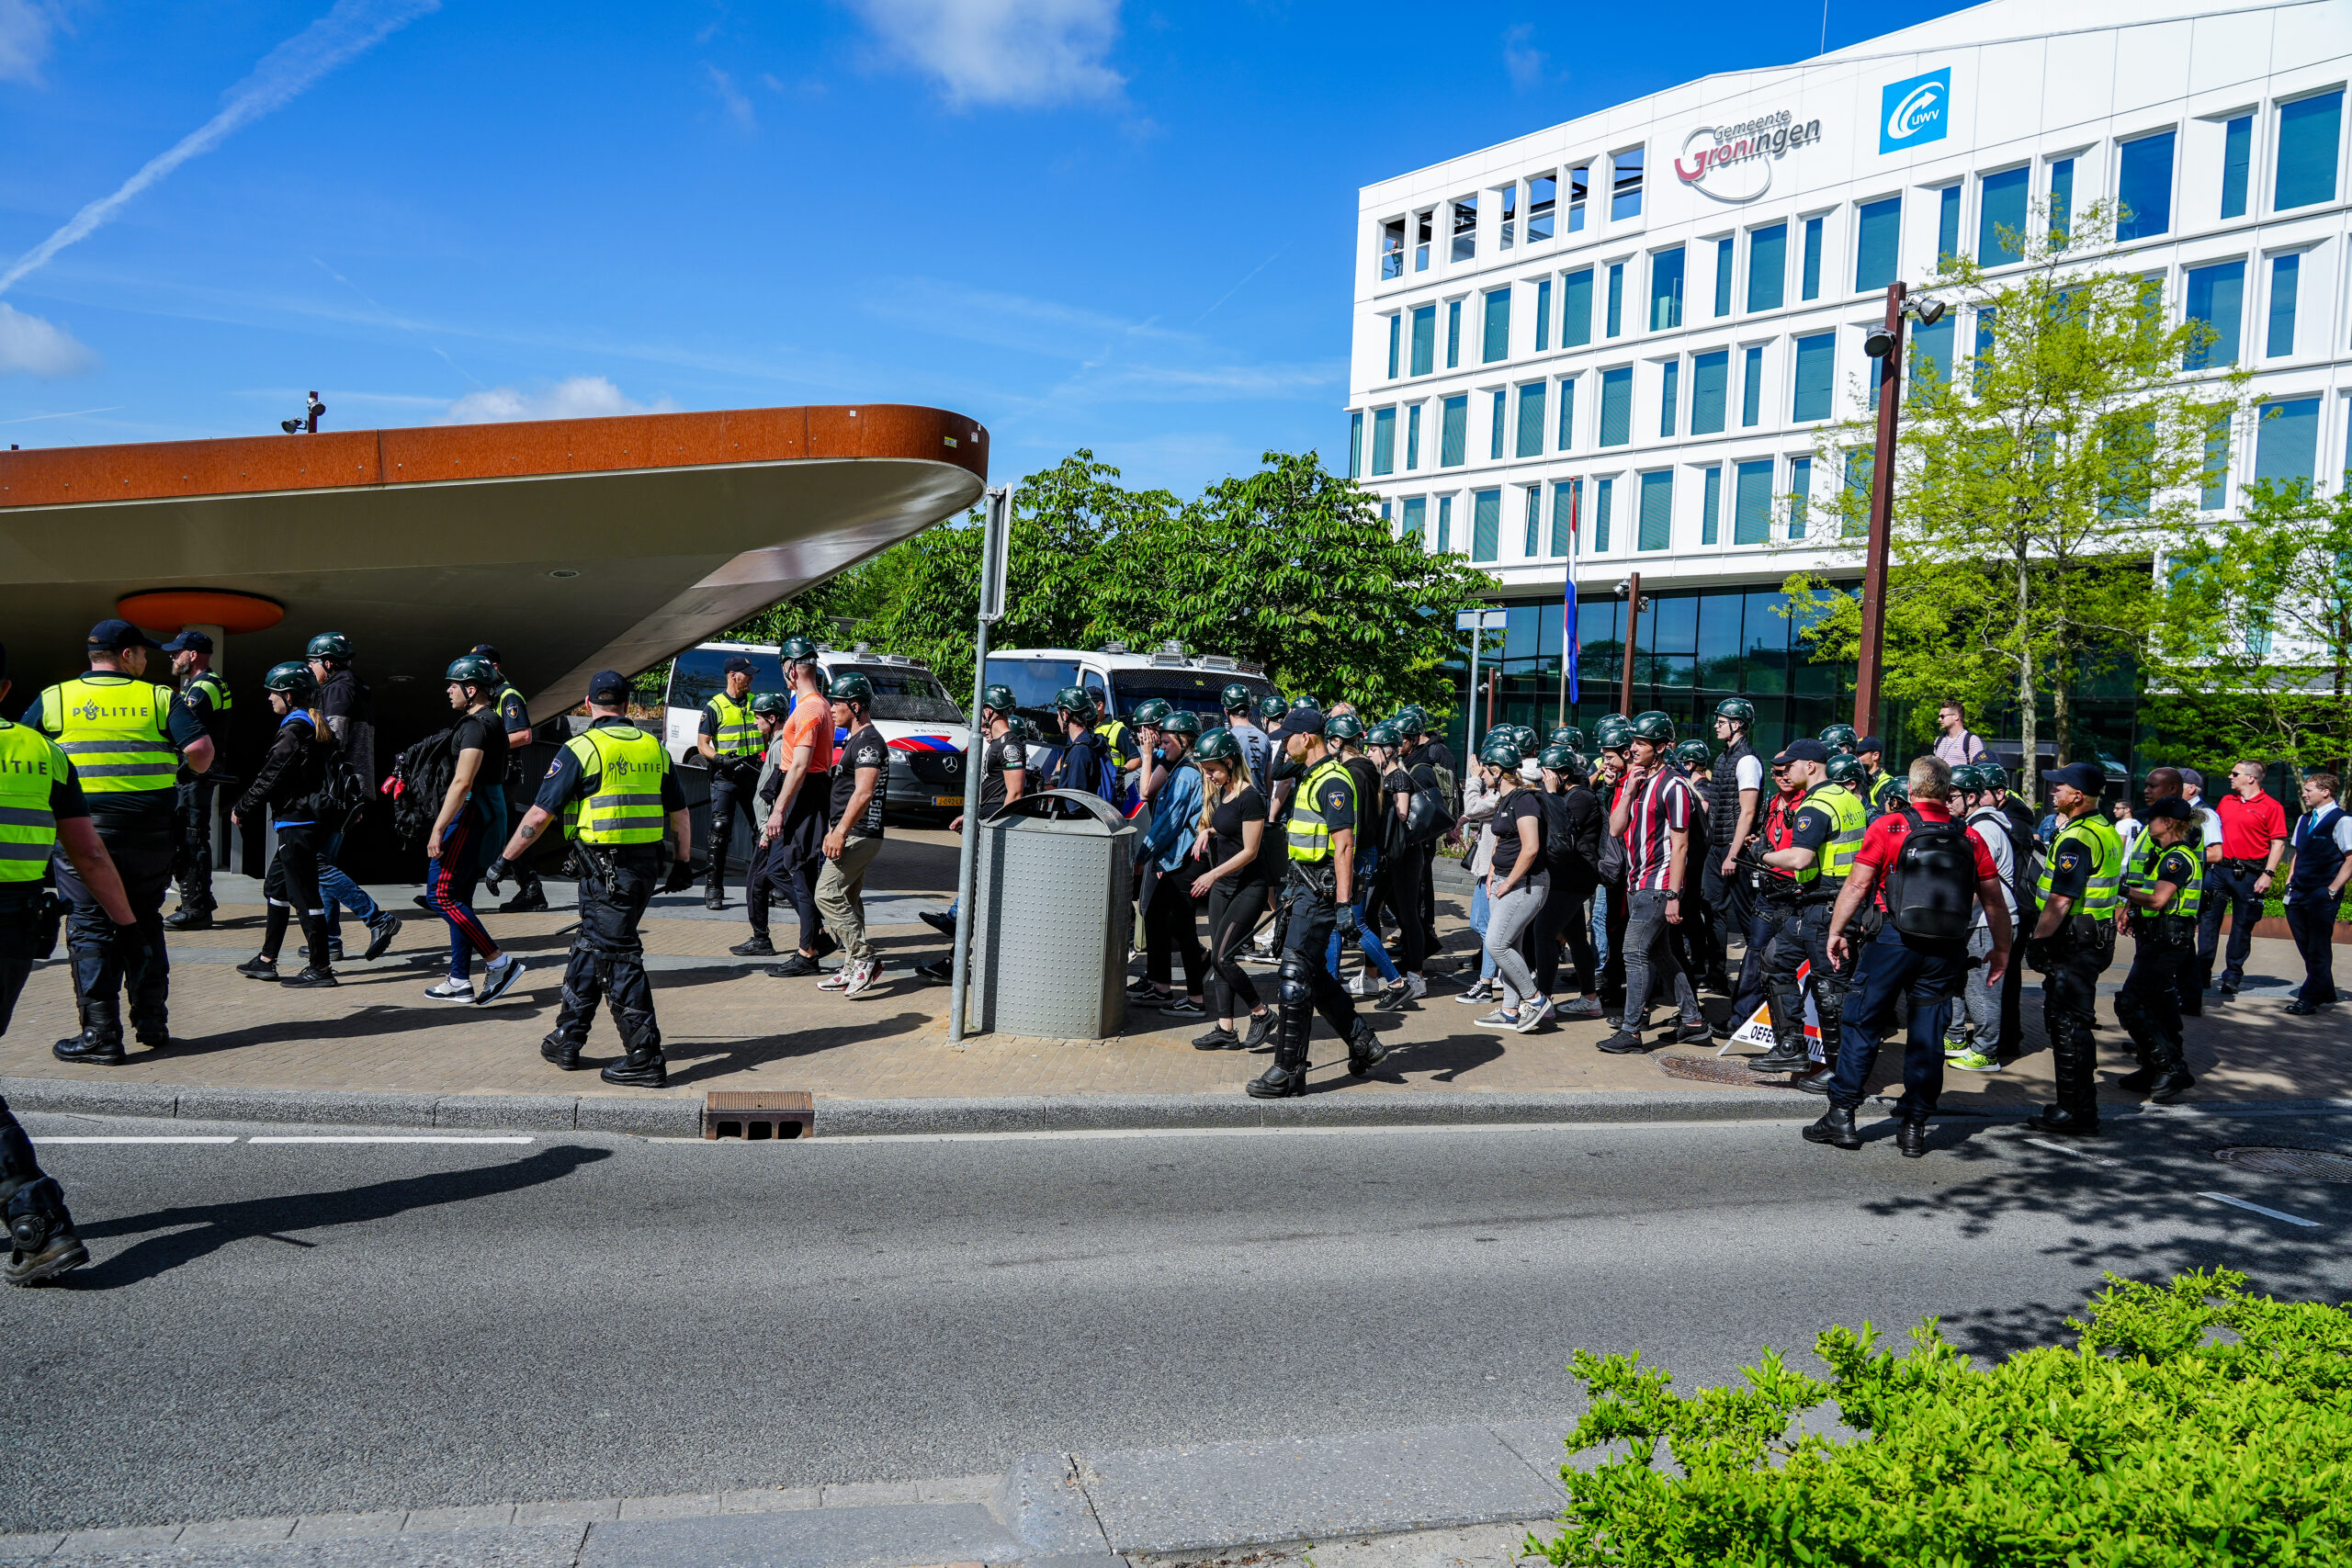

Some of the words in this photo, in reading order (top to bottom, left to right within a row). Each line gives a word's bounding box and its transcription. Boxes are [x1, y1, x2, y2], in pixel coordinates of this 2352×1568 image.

[1713, 109, 1791, 141] Gemeente
[1674, 118, 1821, 182] Groningen
[73, 703, 149, 720] POLITIE
[608, 758, 662, 776] POLITIE
